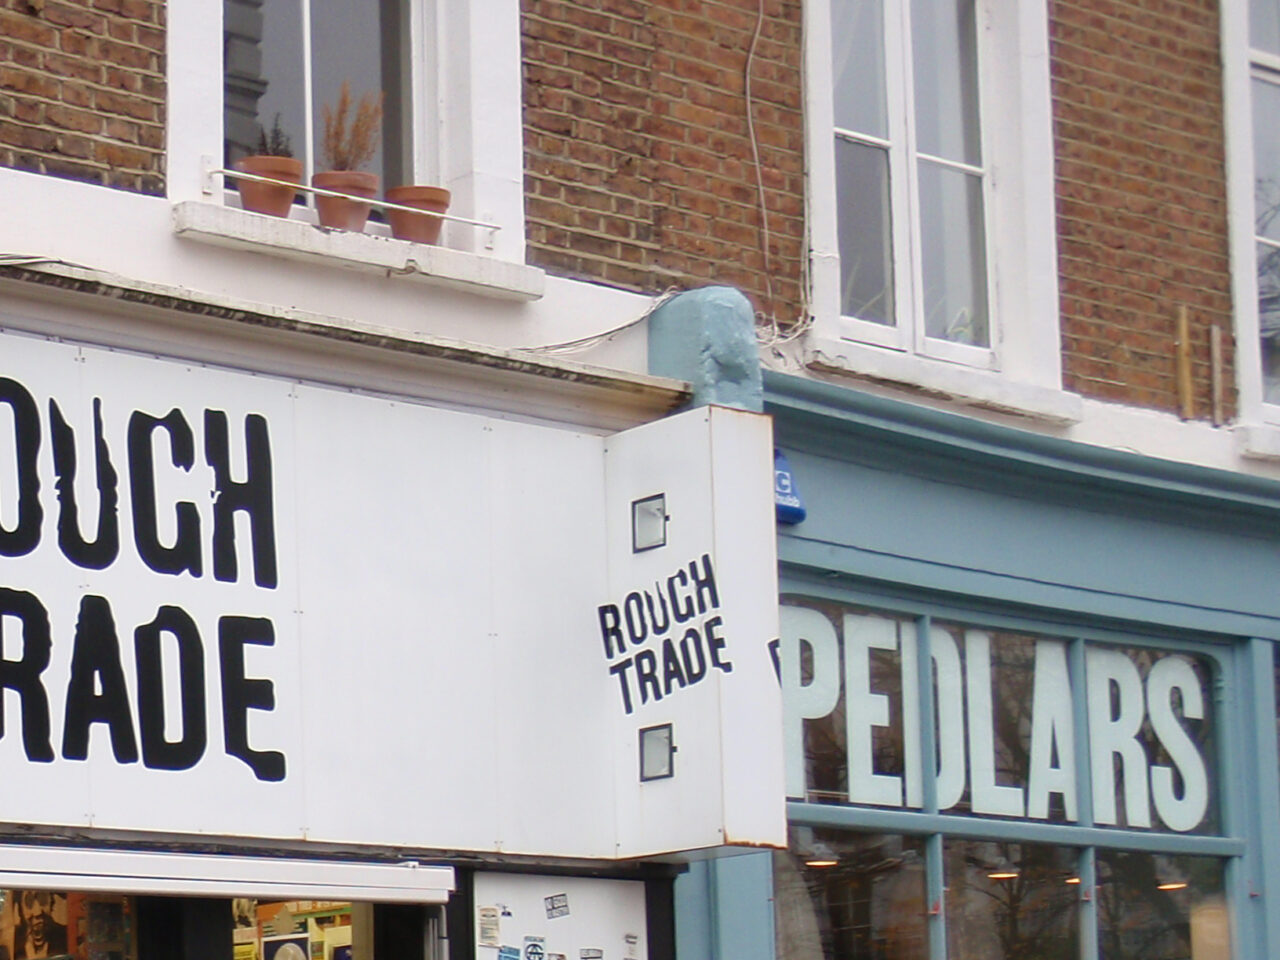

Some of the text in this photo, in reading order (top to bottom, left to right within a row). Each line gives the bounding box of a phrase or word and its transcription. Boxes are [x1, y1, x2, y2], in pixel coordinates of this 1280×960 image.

[598, 554, 720, 660] ROUGH
[610, 616, 733, 715] TRADE
[778, 604, 1209, 832] PEDLARS
